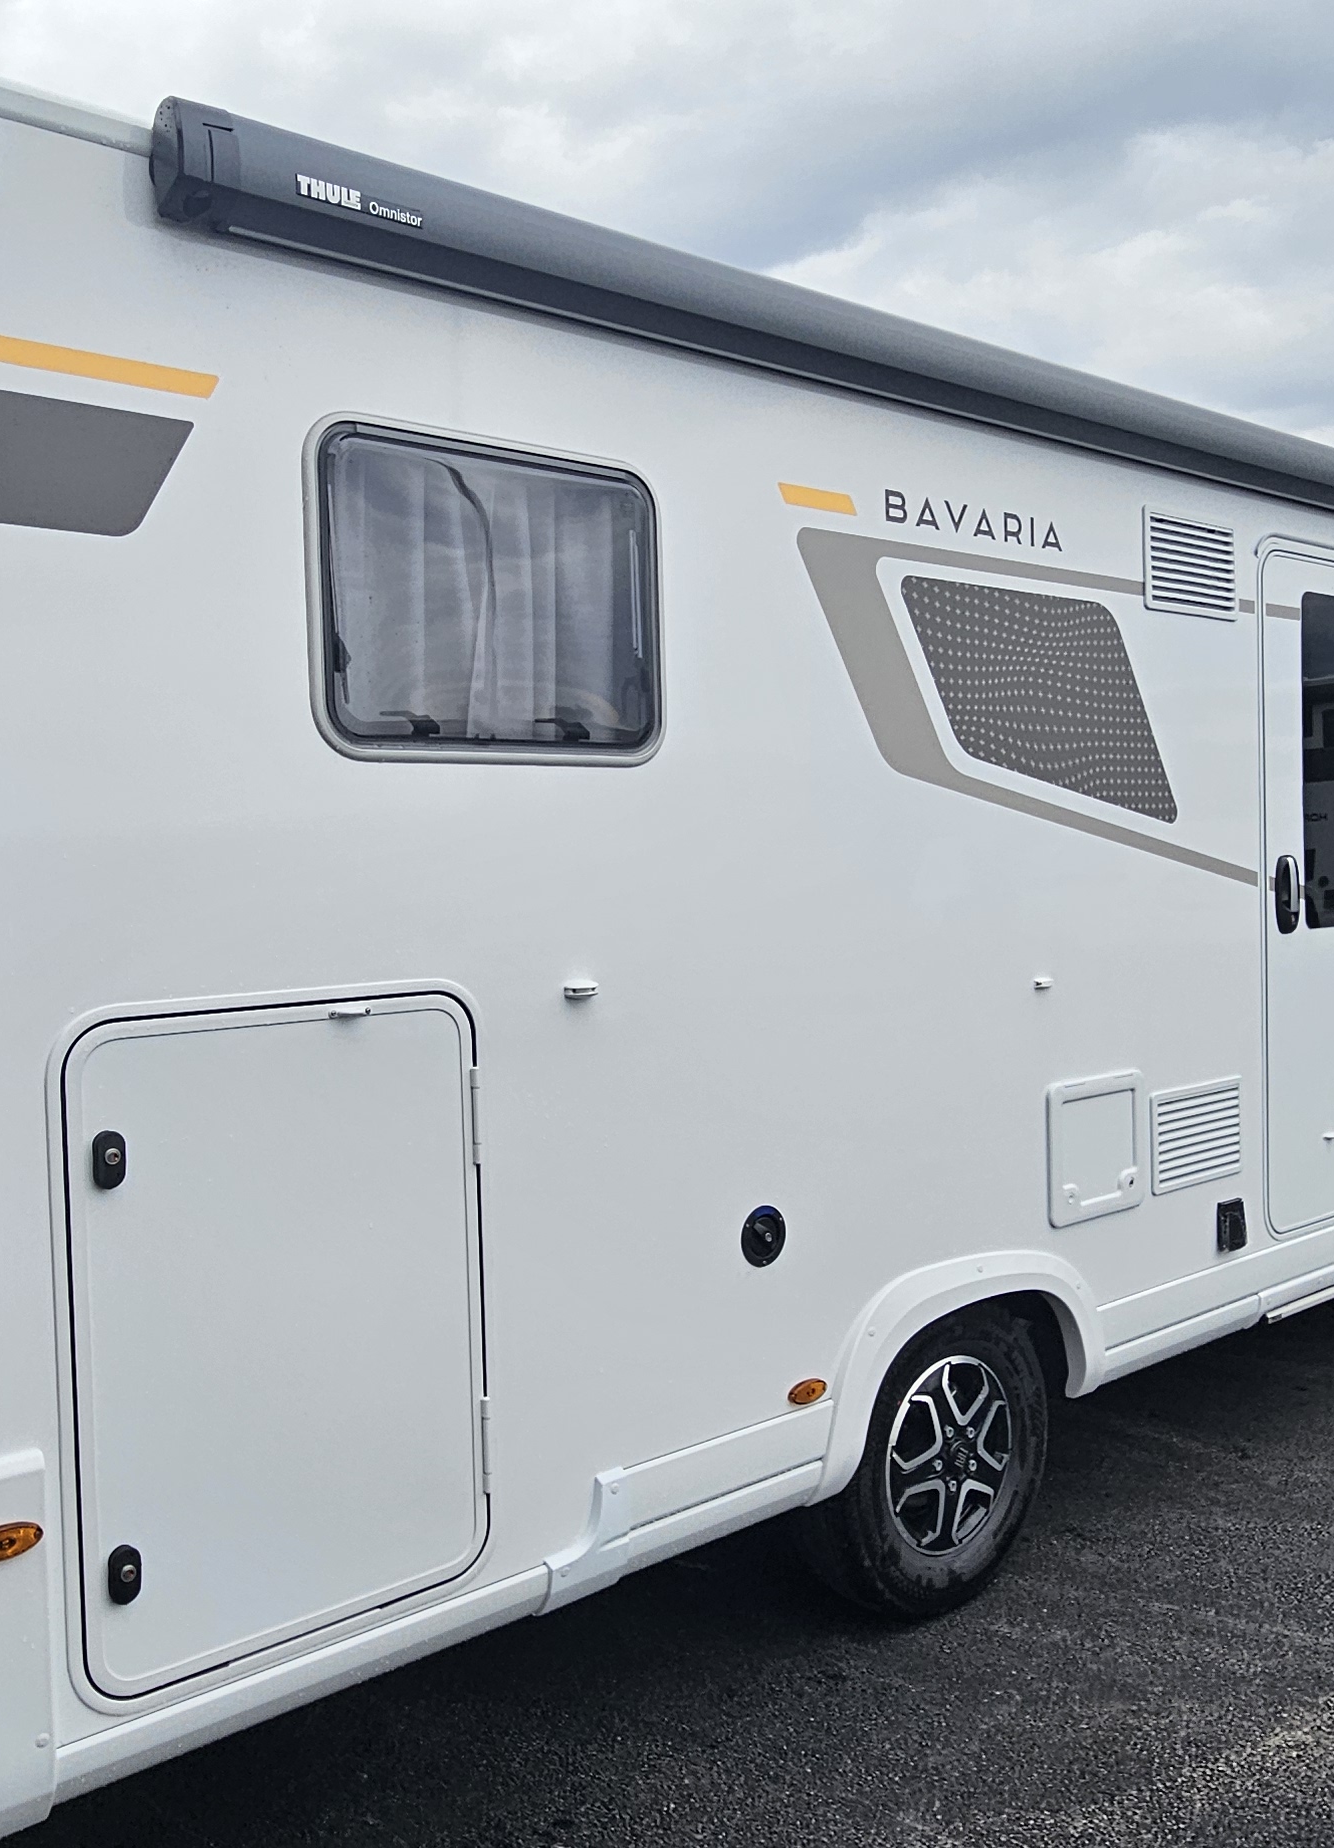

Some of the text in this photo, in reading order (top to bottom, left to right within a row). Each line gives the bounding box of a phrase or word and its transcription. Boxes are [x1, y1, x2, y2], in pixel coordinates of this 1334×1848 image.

[297, 174, 422, 227] THULE Omnistor
[885, 489, 1062, 552] BAVARIA
